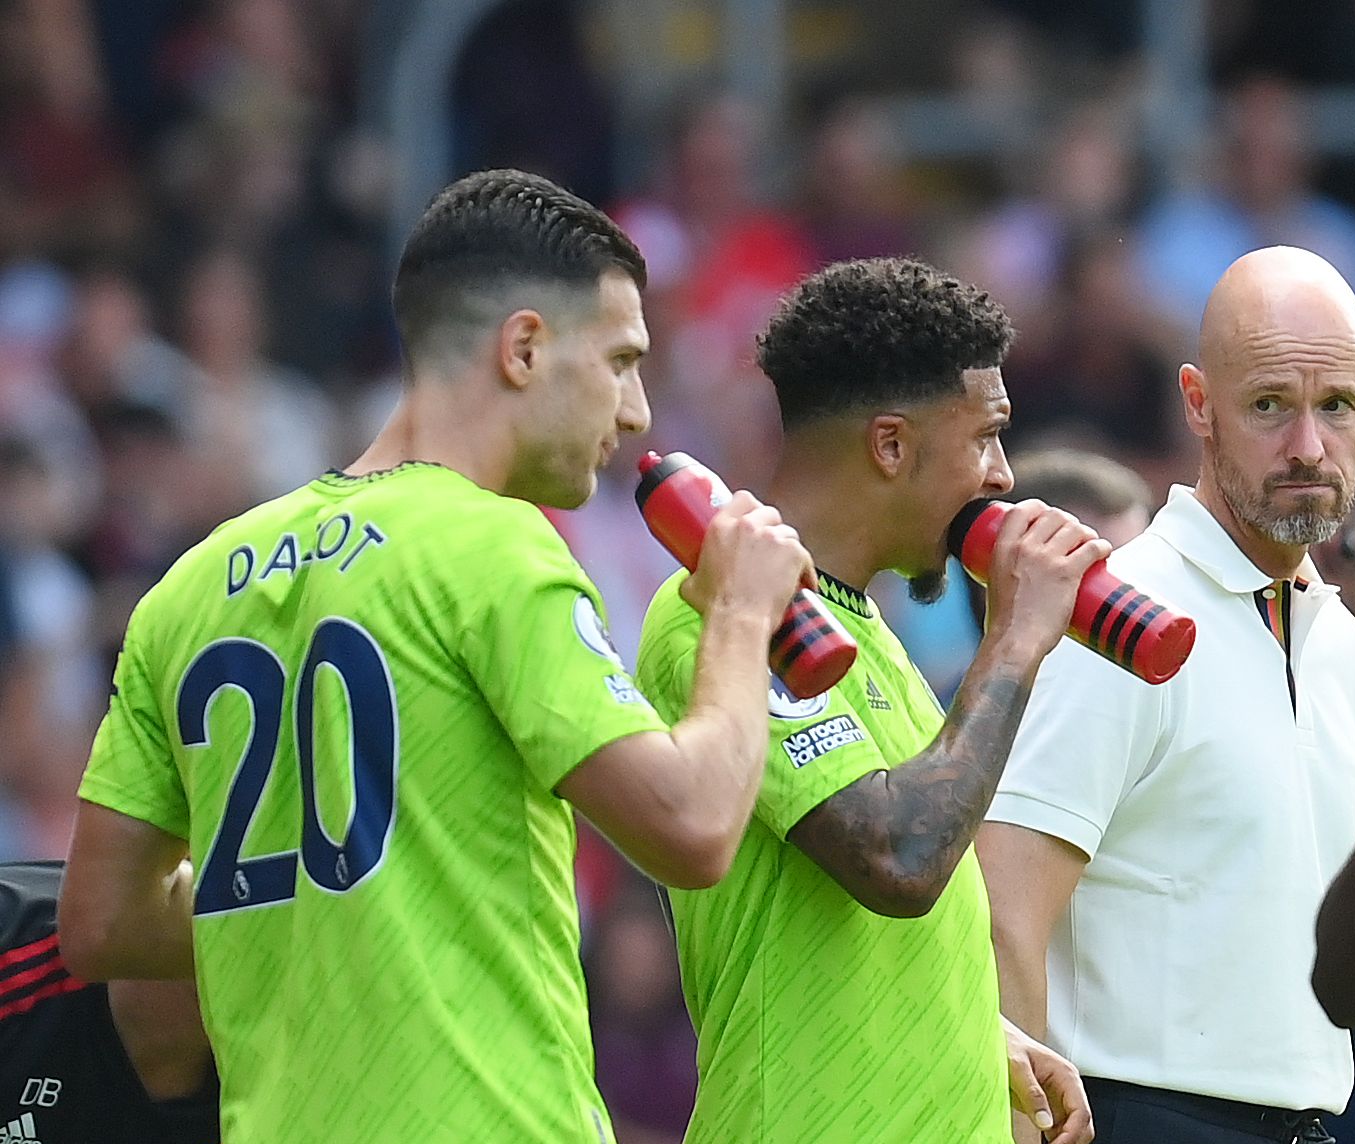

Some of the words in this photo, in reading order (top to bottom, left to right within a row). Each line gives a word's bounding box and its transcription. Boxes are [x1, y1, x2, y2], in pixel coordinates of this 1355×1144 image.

[783, 733, 811, 753] No
[809, 716, 854, 741] room
[175, 614, 400, 918] 20
[19, 1077, 62, 1107] DB
